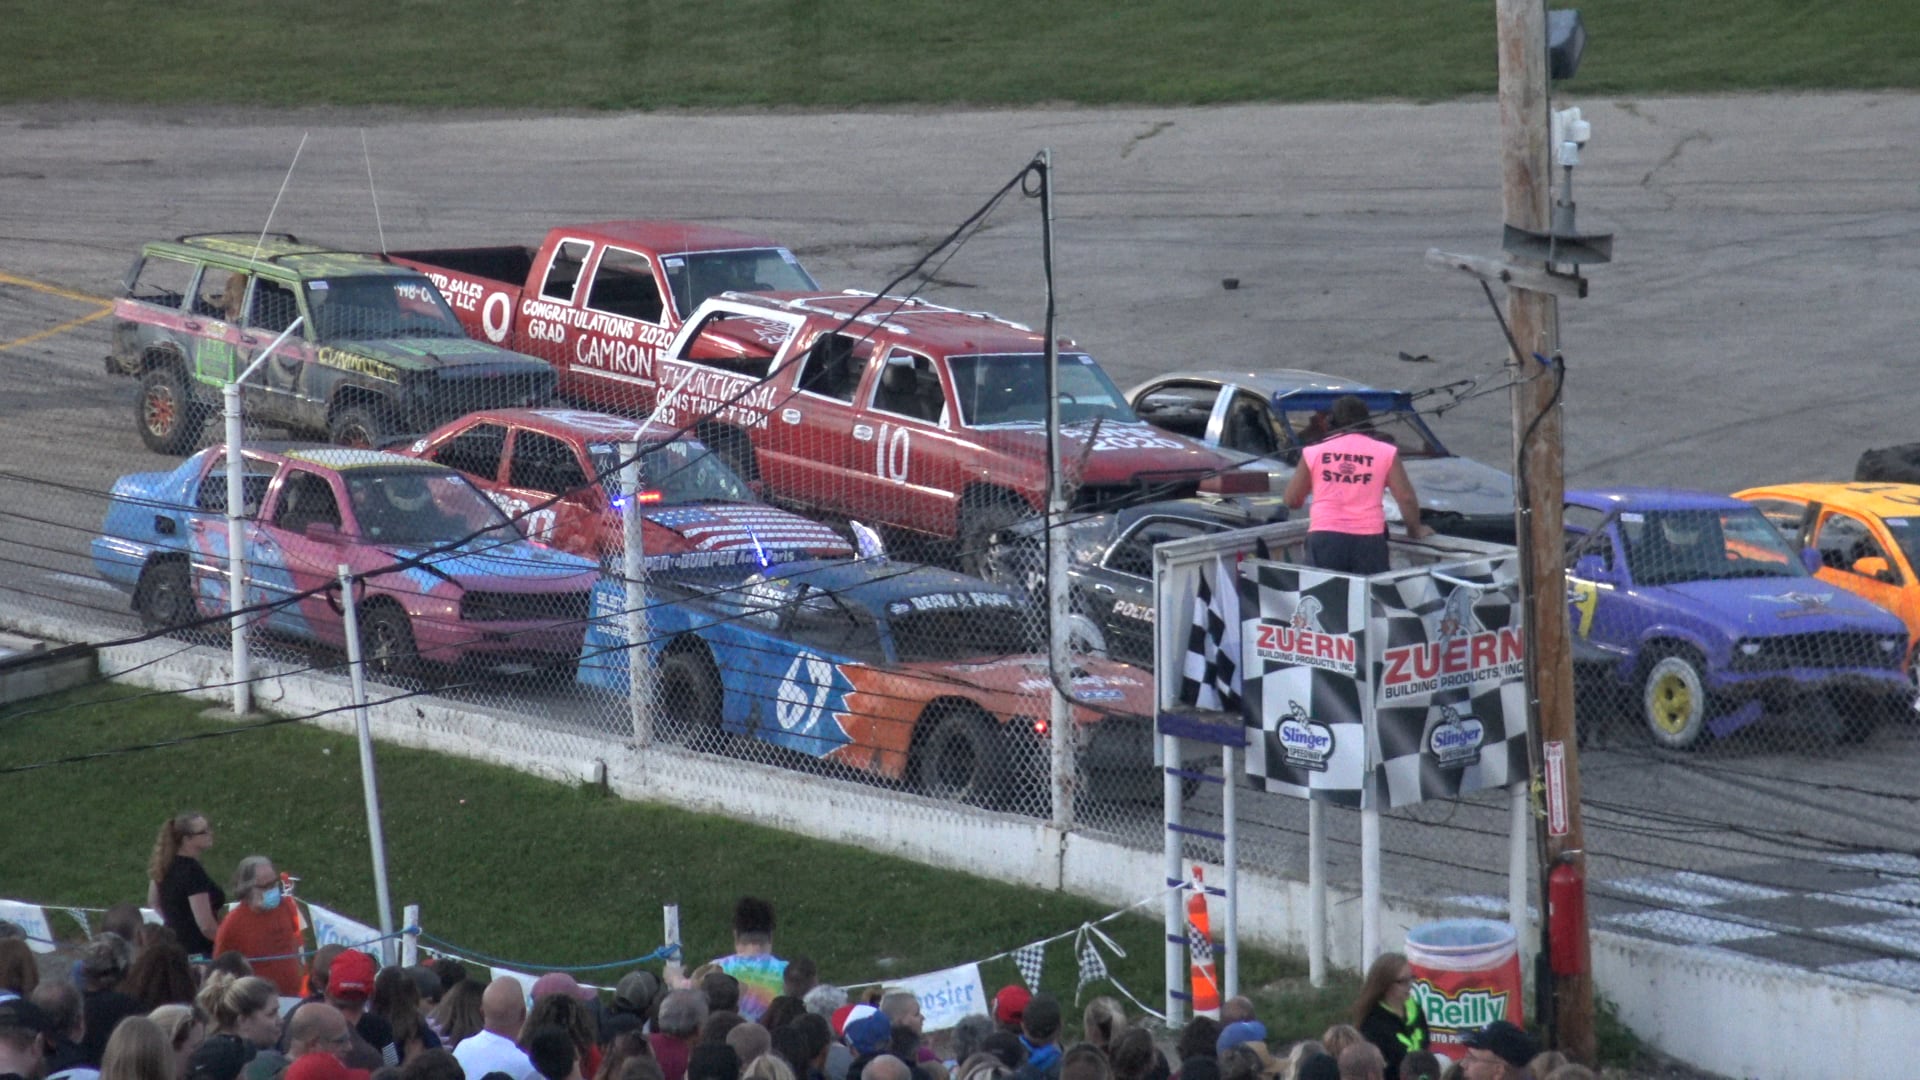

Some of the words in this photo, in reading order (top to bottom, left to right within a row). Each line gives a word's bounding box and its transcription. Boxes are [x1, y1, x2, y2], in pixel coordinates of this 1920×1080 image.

[449, 279, 484, 299] SALES
[456, 294, 477, 311] LLC
[522, 299, 635, 339] CONGRATULATIONS
[638, 325, 675, 349] 2020
[528, 319, 565, 343] GRAD
[576, 334, 653, 377] CAMRON
[687, 370, 777, 410] UNIVERSAL
[876, 422, 910, 485] 10
[1080, 437, 1185, 450] 2020
[1322, 452, 1374, 467] EVENT
[1322, 470, 1373, 485] STAFF
[1257, 625, 1354, 662] ZUERN
[1257, 648, 1293, 661] BUILDING
[1384, 628, 1524, 685] ZUERN
[1385, 679, 1438, 699] BUILDING
[1282, 726, 1329, 749] Slinger
[1433, 728, 1481, 749] Slinger
